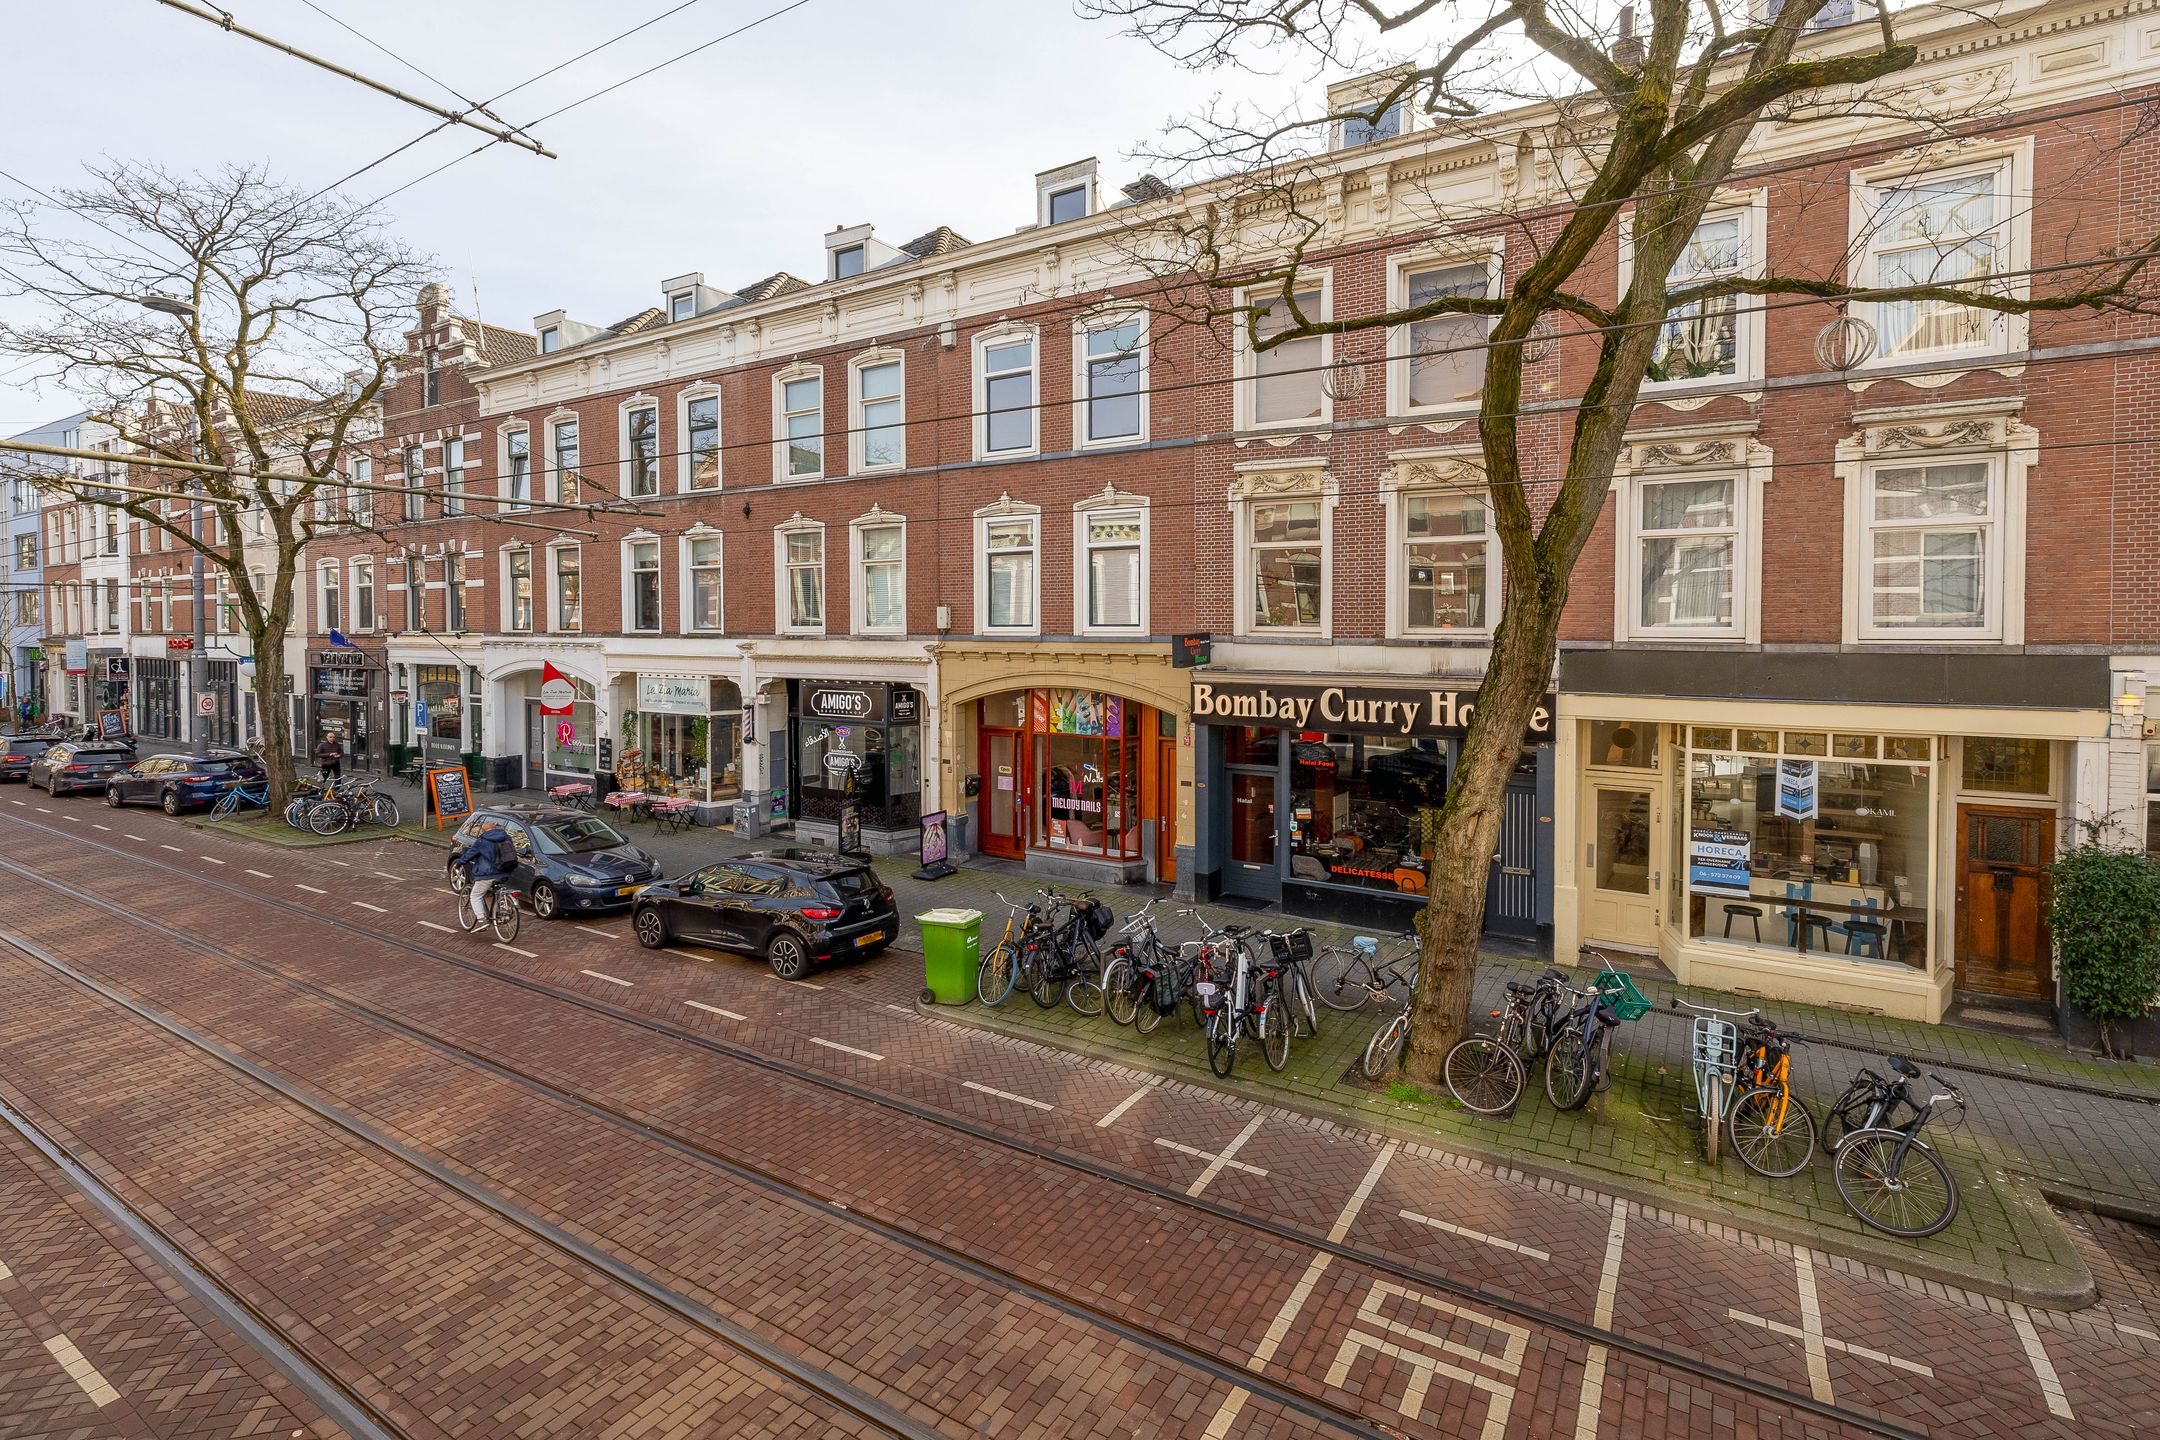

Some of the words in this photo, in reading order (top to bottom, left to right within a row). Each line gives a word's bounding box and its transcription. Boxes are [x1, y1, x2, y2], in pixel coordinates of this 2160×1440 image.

[646, 684, 656, 695] La
[674, 685, 701, 698] Maria
[821, 693, 862, 711] AMIGO'S
[895, 701, 914, 709] AMIGO'S
[1192, 684, 1314, 727] Bombay
[1320, 687, 1420, 733] Curry
[1429, 691, 1549, 731] Hoe
[417, 703, 424, 717] P
[829, 756, 856, 768] AMIGO'S
[1713, 833, 1723, 842] &
[1697, 845, 1743, 857] HORECA
